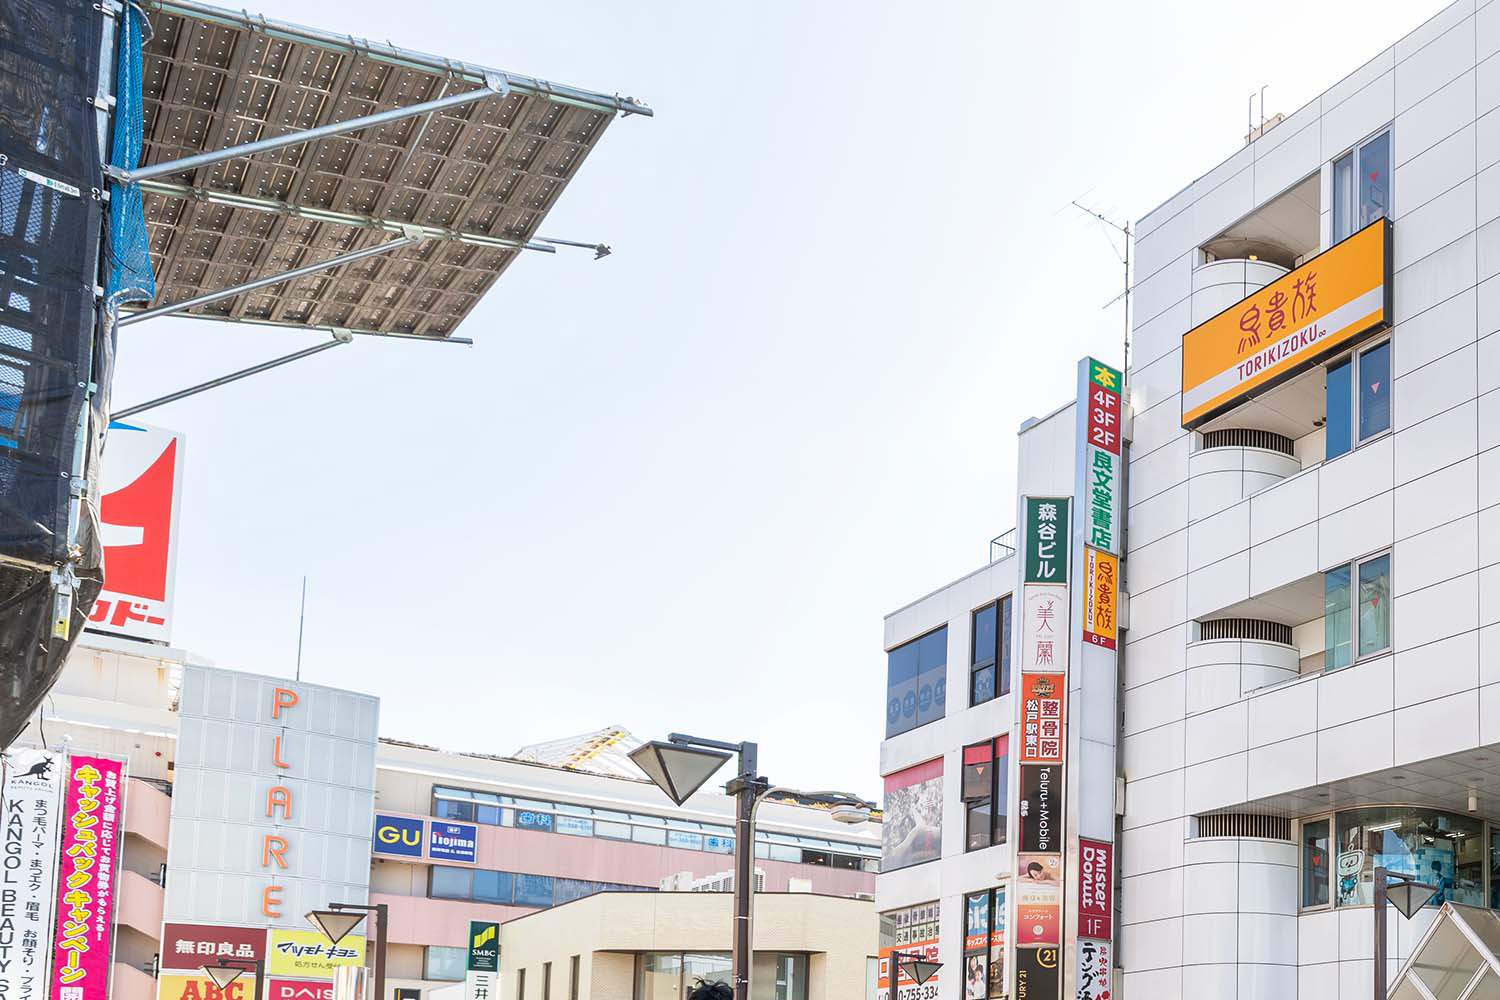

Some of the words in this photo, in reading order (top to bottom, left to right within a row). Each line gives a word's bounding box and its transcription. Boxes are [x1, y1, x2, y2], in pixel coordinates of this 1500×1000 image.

[1237, 271, 1318, 354] 鳥貴族
[1237, 324, 1319, 381] TORIKIZOKU
[1094, 366, 1115, 388] 本
[1093, 390, 1116, 409] 4F
[1093, 408, 1115, 427] 3F
[1092, 426, 1115, 446] 2F
[1091, 450, 1113, 550] 良文堂書店
[1036, 503, 1057, 579] 森谷ビル
[1091, 633, 1106, 645] 6F
[1026, 700, 1038, 757] 松戸駅東口
[1042, 700, 1059, 757] 整骨院
[11, 780, 54, 790] KANGOL
[261, 687, 299, 918] PLARE
[1039, 767, 1051, 850] Teluru+Mobile
[4, 799, 25, 884] KANGOL
[377, 826, 420, 847] GU
[1087, 919, 1103, 935] 1F
[175, 939, 255, 958] 無印良品
[277, 942, 358, 959] マツモトキヨシ
[472, 949, 496, 957] SMBC
[1043, 949, 1057, 962] 21
[280, 987, 333, 1000] DAIS
